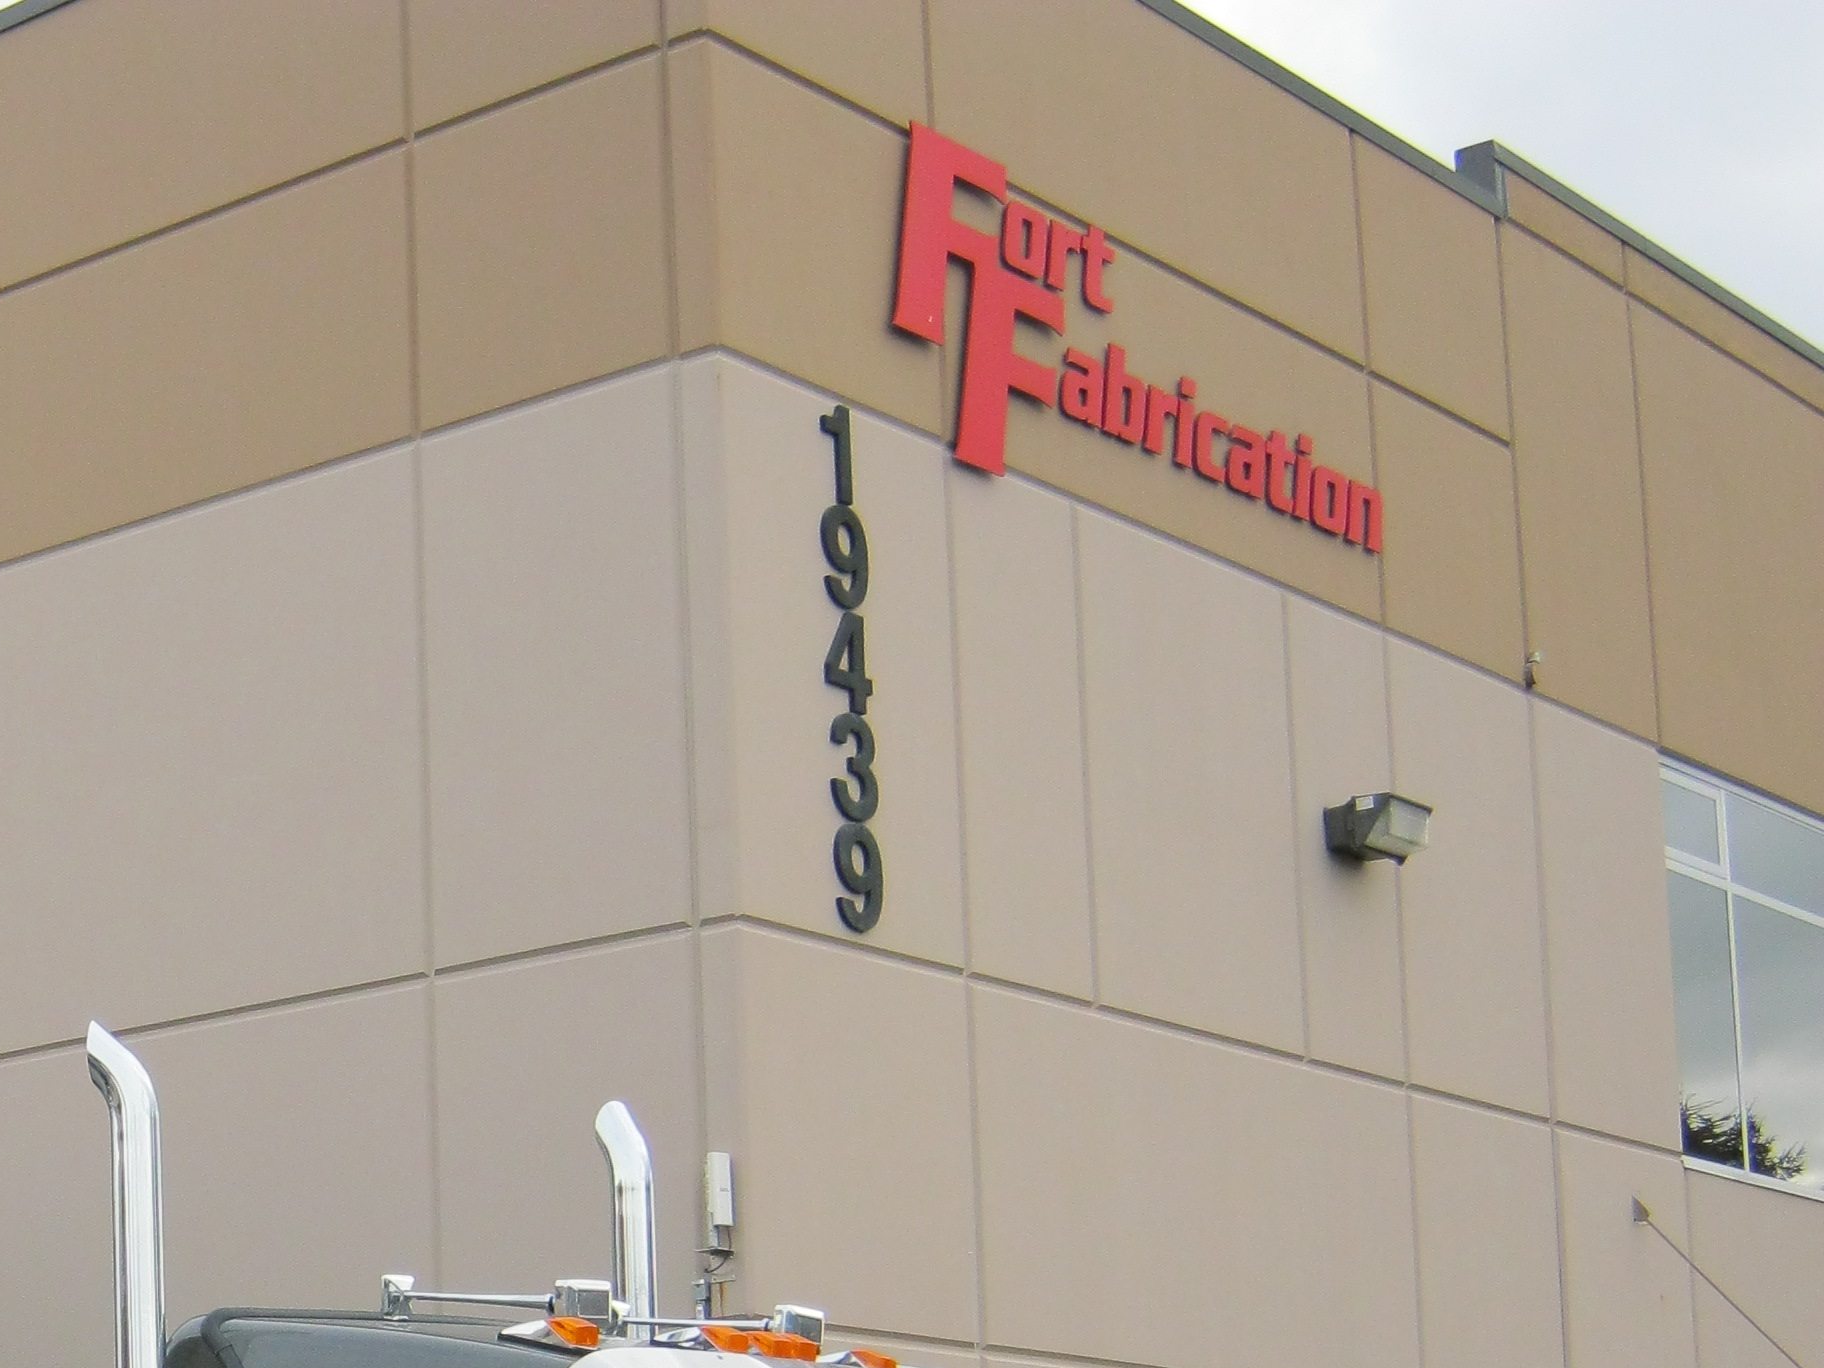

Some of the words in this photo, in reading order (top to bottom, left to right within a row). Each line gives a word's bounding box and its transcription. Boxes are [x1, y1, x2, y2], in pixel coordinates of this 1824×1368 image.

[891, 120, 1115, 347] Fort
[953, 272, 1384, 554] Fabrication
[819, 404, 884, 934] 19439
